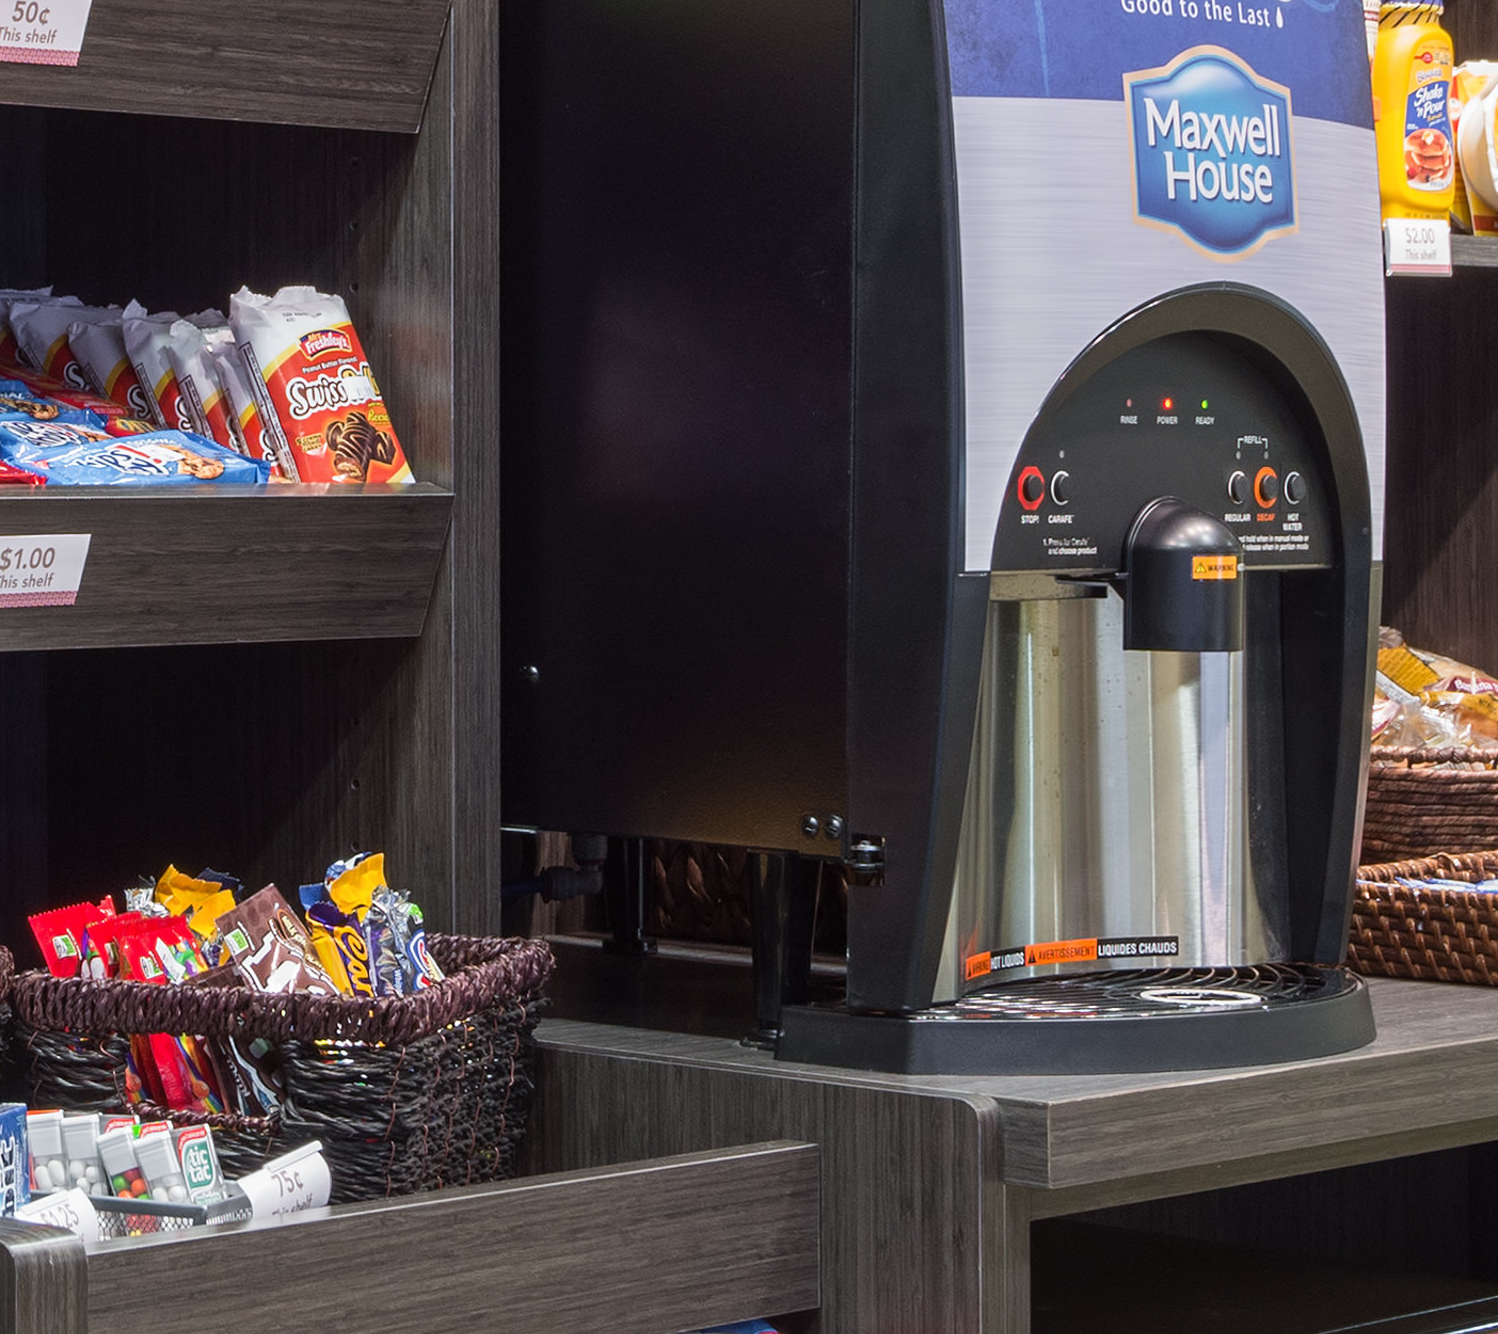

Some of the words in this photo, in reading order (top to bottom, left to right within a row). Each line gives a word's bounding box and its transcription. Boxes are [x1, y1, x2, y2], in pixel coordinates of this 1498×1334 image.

[12, 0, 51, 25] 50¢
[1238, 2, 1270, 27] Last
[1143, 98, 1281, 158] Maxwell
[1164, 151, 1273, 204] House
[1048, 515, 1073, 524] CARAFE
[1225, 513, 1251, 523] REGULAR
[1257, 513, 1276, 522] DECAF
[1283, 522, 1303, 531] WATER
[22, 573, 54, 587] shelf
[189, 1148, 210, 1165] tic
[189, 1163, 213, 1183] tac
[272, 1168, 304, 1198] 75¢
